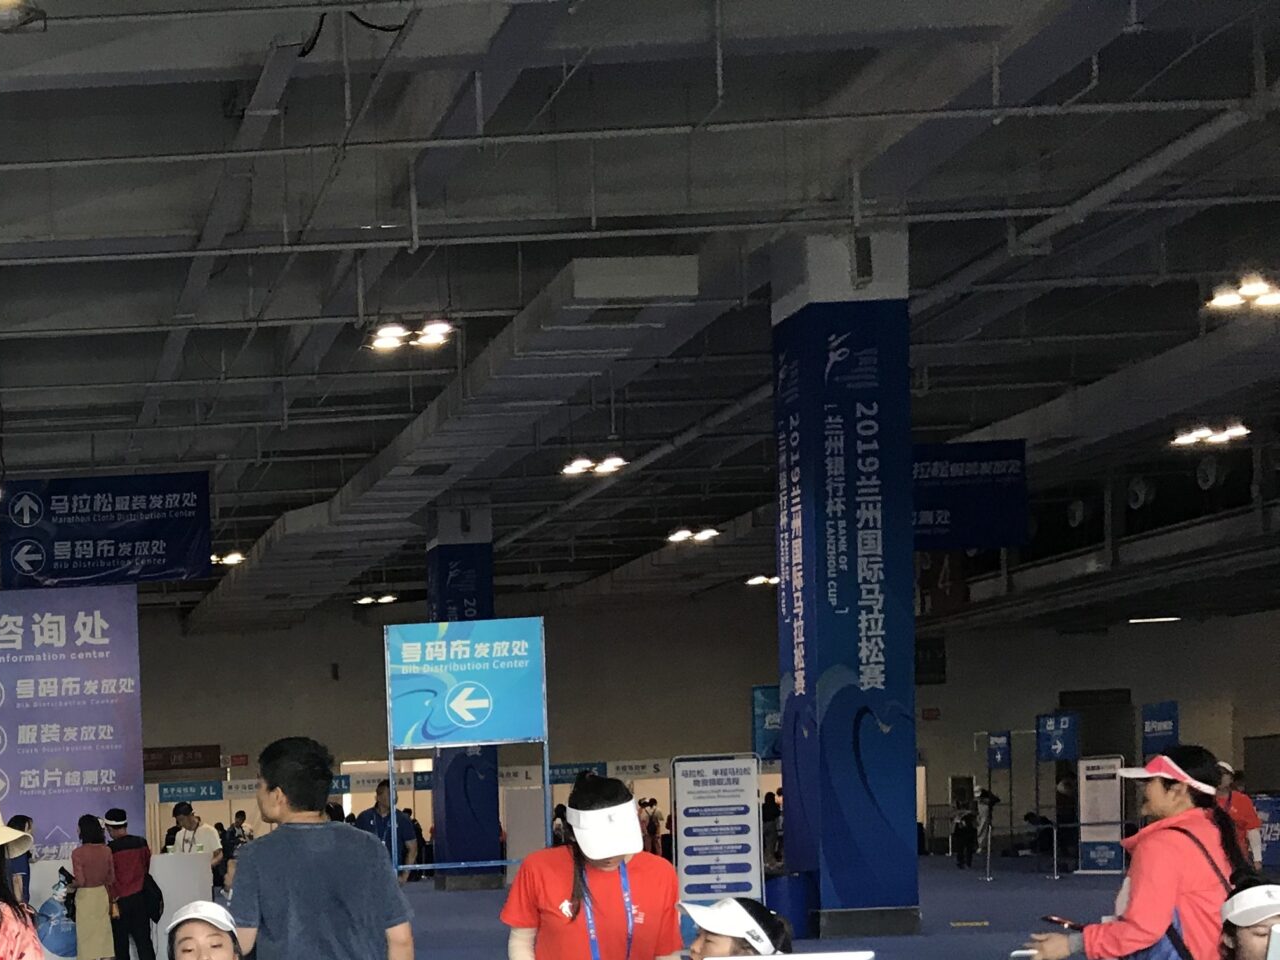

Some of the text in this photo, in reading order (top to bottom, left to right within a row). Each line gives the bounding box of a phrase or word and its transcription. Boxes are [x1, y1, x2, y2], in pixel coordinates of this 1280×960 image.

[50, 491, 198, 514] 马拉松服装发放处
[51, 509, 197, 524] Marathon Cloth Distribution Center
[53, 539, 167, 560] 号码布发放处
[837, 519, 849, 571] BANK OF
[855, 401, 886, 692] 2019兰州国际马拉松赛
[72, 559, 134, 569] Distribution
[135, 557, 166, 567] Center
[826, 519, 838, 607] LANZHOU CUP
[70, 650, 111, 660] center
[401, 639, 529, 663] 号码布发放处
[401, 659, 530, 675] Bib Distribution Center
[15, 677, 136, 699] 号码布发放处
[18, 723, 114, 745] 服装发放处
[20, 768, 117, 789] 芯片检测处
[653, 764, 660, 773] S
[200, 786, 216, 795] XL
